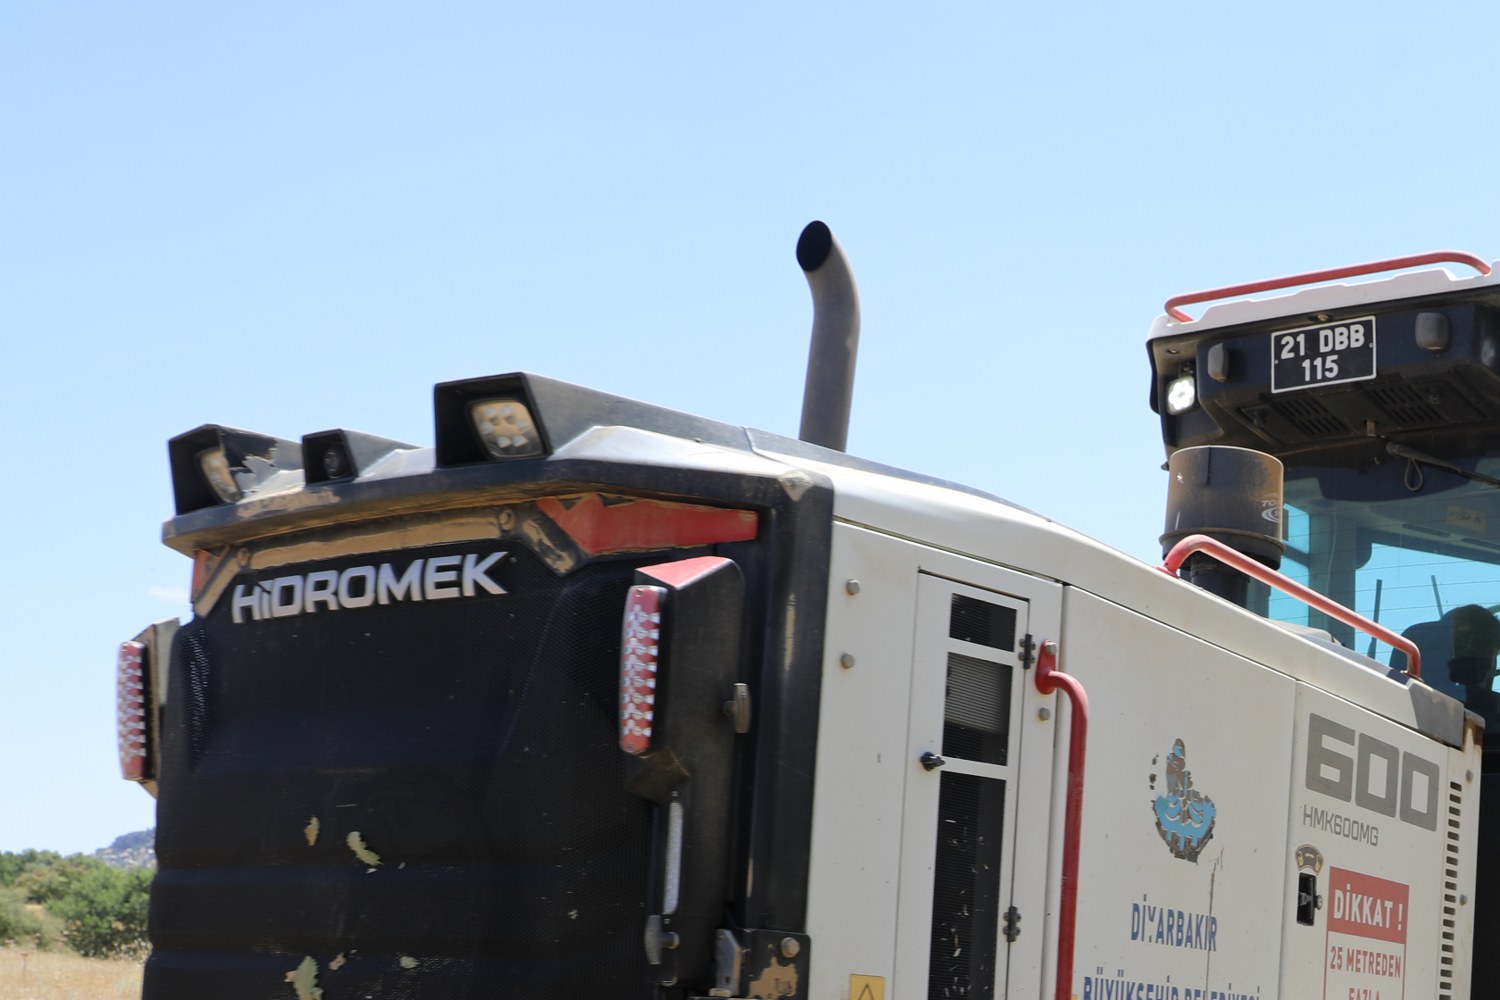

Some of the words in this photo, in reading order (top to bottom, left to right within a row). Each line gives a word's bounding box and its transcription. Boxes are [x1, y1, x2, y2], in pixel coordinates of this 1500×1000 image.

[1281, 333, 1305, 359] 21
[1319, 324, 1365, 353] DBB
[1302, 354, 1338, 381] 115
[1305, 712, 1440, 832] 600
[1302, 804, 1379, 847] HMK600MG
[1131, 893, 1217, 951] DİYARBAKIR
[1333, 883, 1393, 929] DİKKAT
[1330, 946, 1343, 970] 25
[1346, 948, 1401, 979] METREDEN
